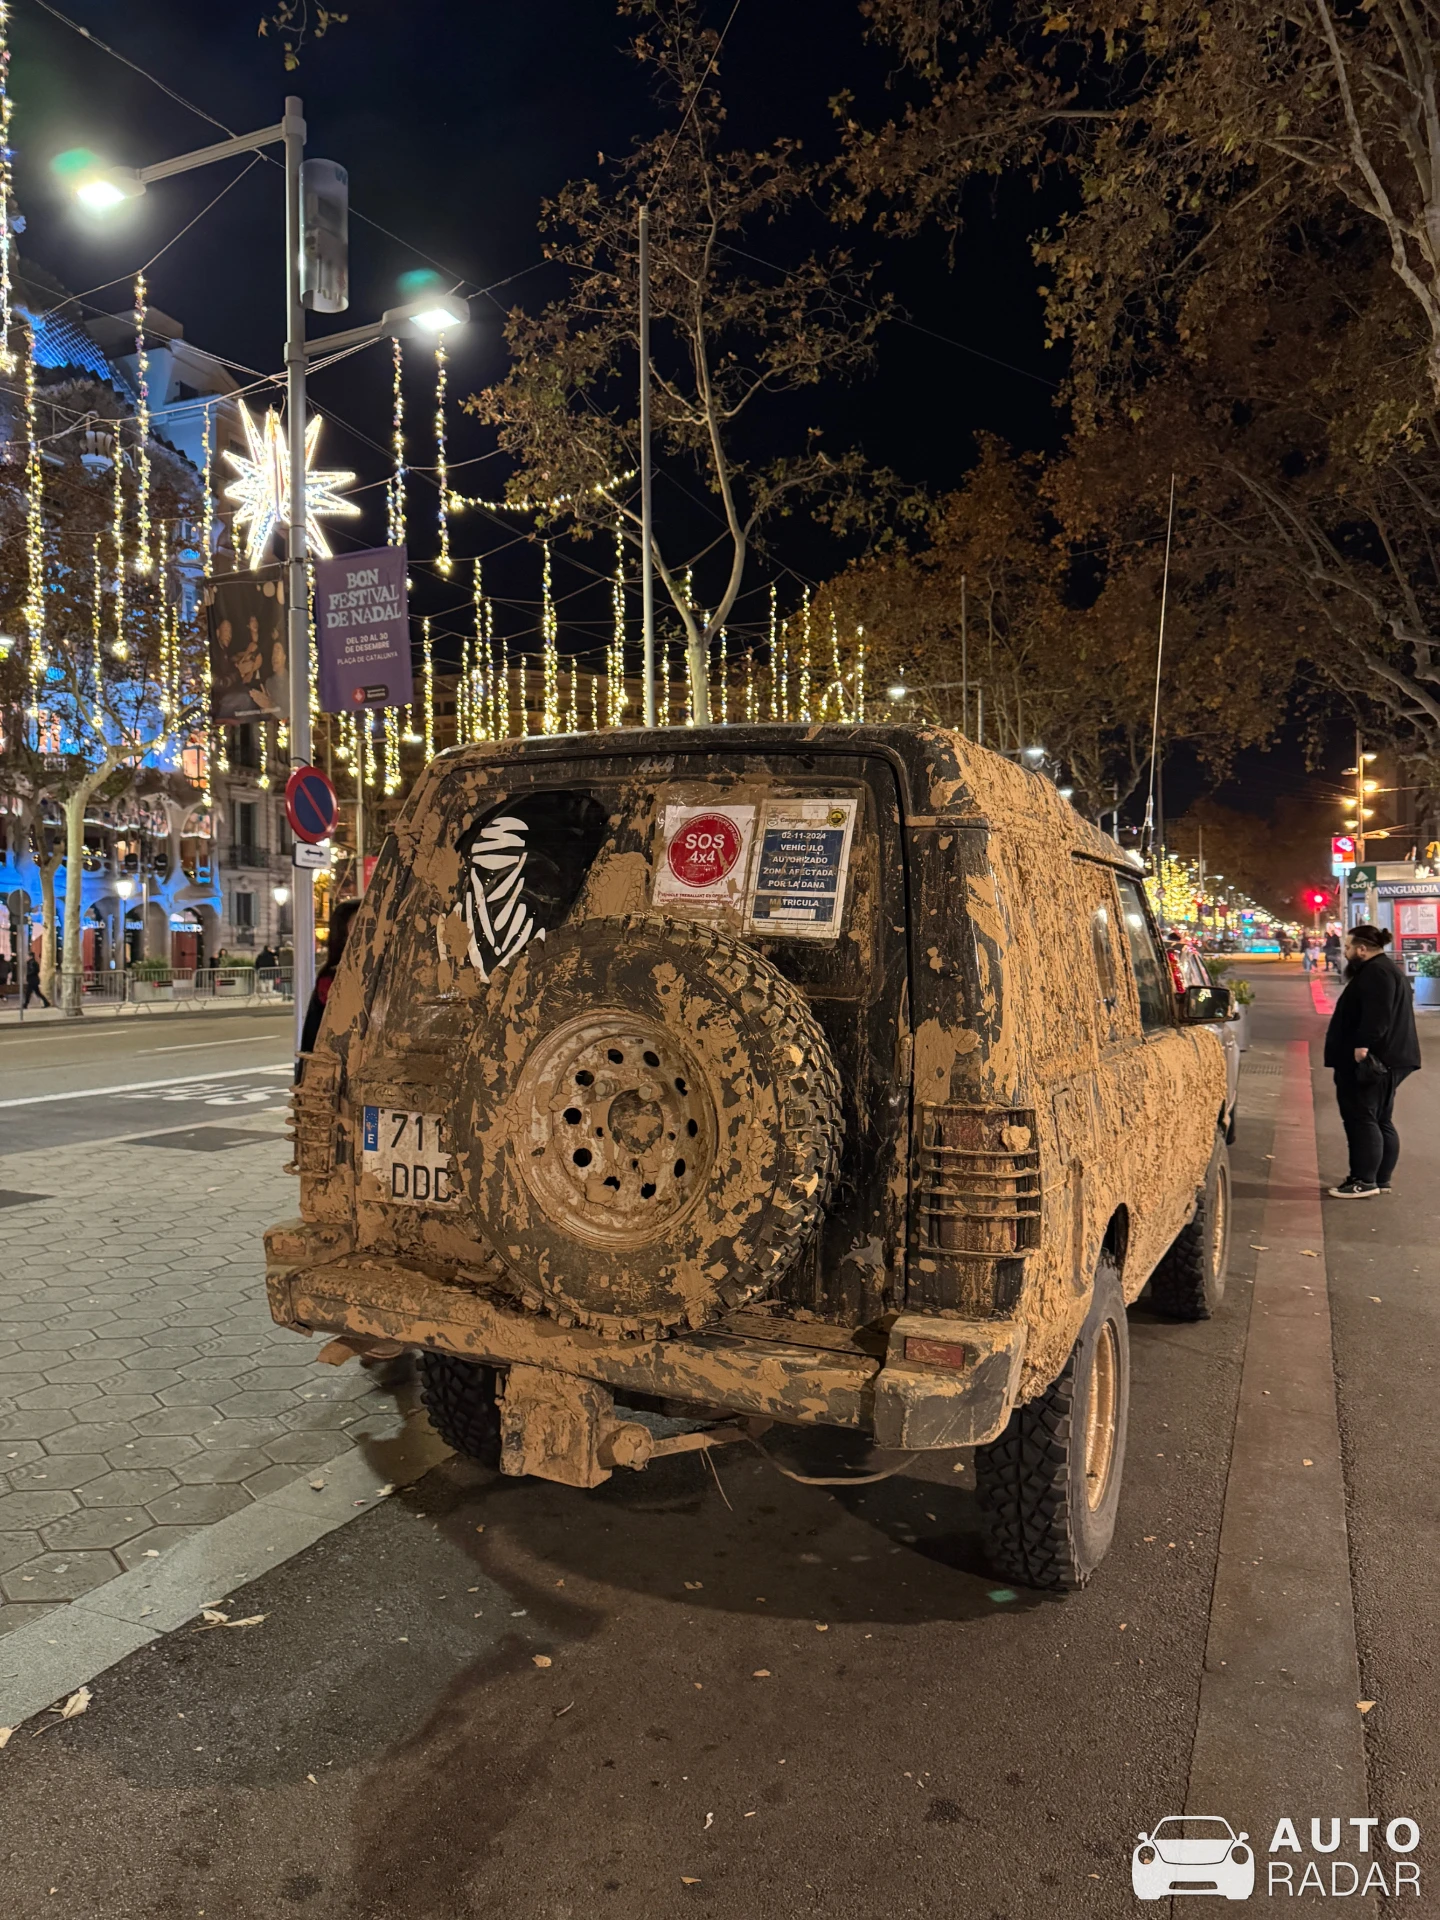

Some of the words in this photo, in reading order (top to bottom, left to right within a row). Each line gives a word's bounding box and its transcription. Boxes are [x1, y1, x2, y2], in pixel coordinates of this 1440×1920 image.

[346, 569, 378, 588] BON
[328, 584, 400, 610] FESTIVAL
[326, 611, 349, 628] DE
[351, 602, 402, 626] NADAL
[346, 636, 359, 645] DEL
[360, 635, 369, 643] 20
[370, 633, 379, 641] AL
[379, 632, 388, 640] 30
[345, 645, 355, 653] DE
[356, 641, 390, 652] DESEMBRE
[357, 655, 365, 663] DE
[366, 651, 398, 662] CATALUNYA
[685, 834, 725, 849] SOS
[781, 831, 826, 840] 02-11-2024
[781, 843, 824, 852] VEHÍCULO
[690, 850, 715, 863] 4x4
[772, 856, 828, 864] AUTORIZADO
[763, 867, 787, 875] ZONA
[768, 880, 786, 888] POR
[788, 880, 799, 888] LA
[801, 881, 825, 889] DANA
[1377, 885, 1439, 895] VANGUARDIA
[367, 1134, 375, 1144] E
